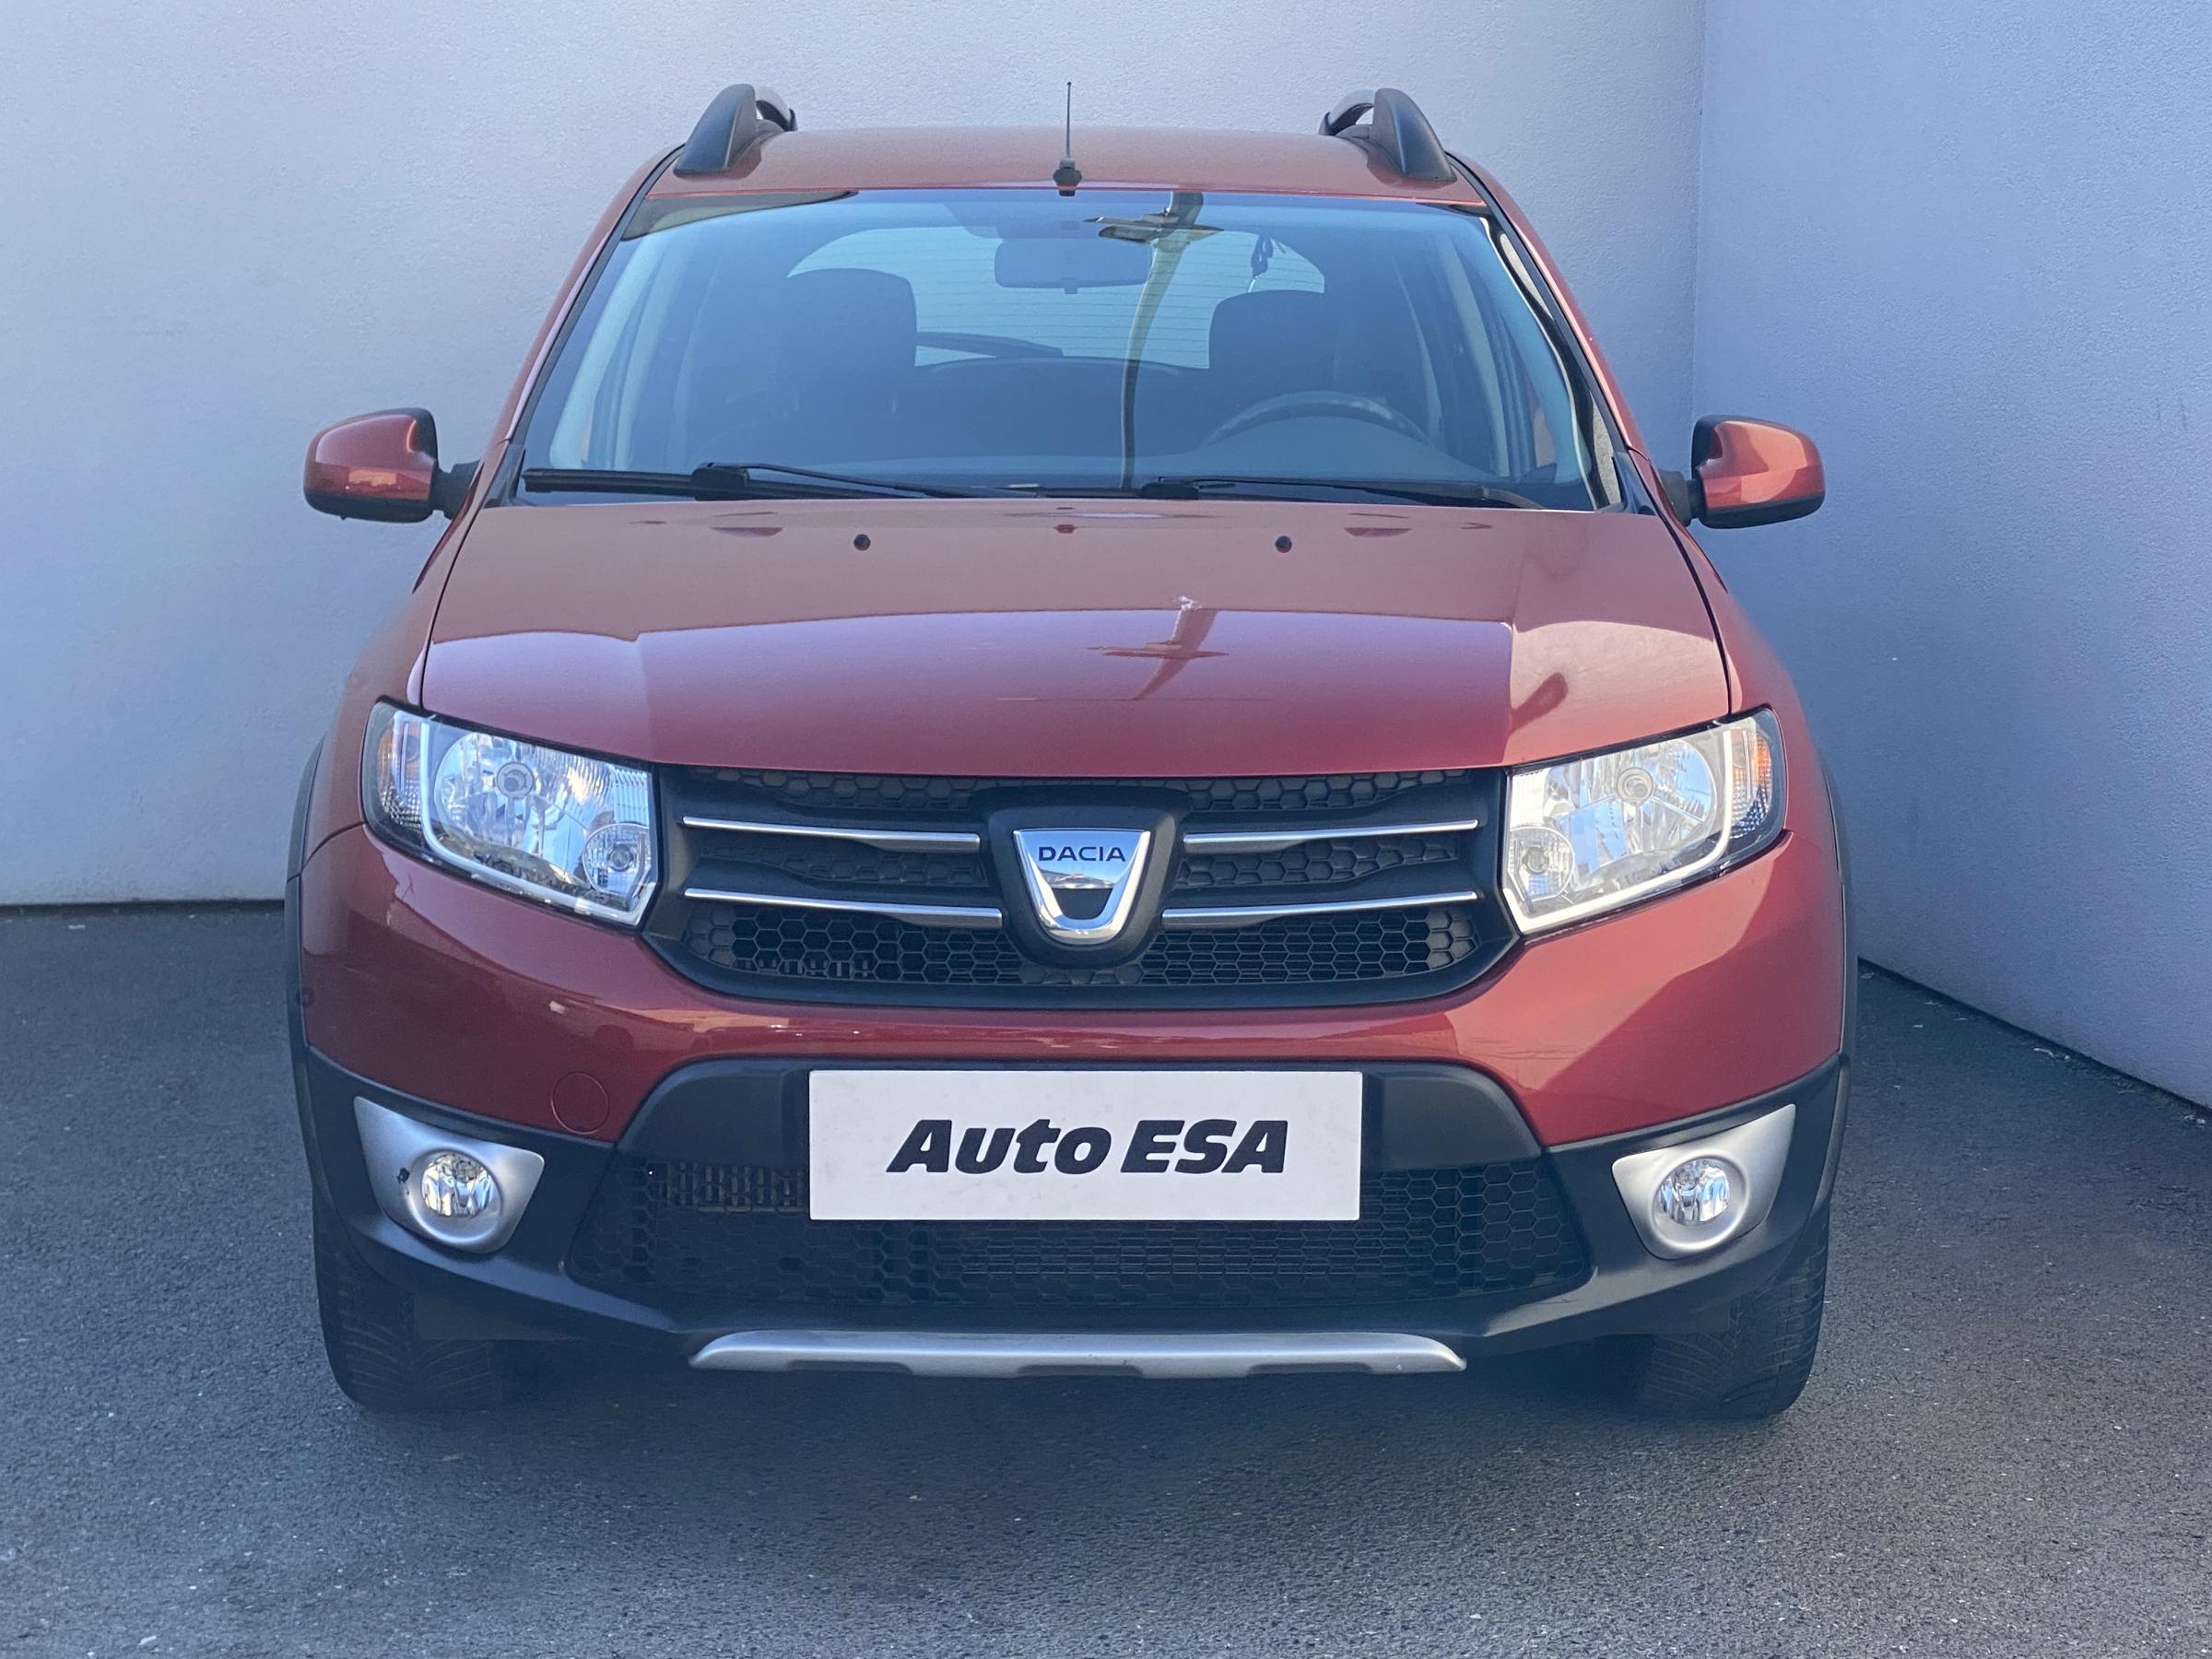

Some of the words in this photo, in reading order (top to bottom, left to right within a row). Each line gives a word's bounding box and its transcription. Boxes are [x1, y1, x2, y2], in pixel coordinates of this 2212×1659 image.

[1038, 846, 1126, 863] DACIA
[886, 1118, 1112, 1174] Auto
[1120, 1118, 1288, 1173] ESA
